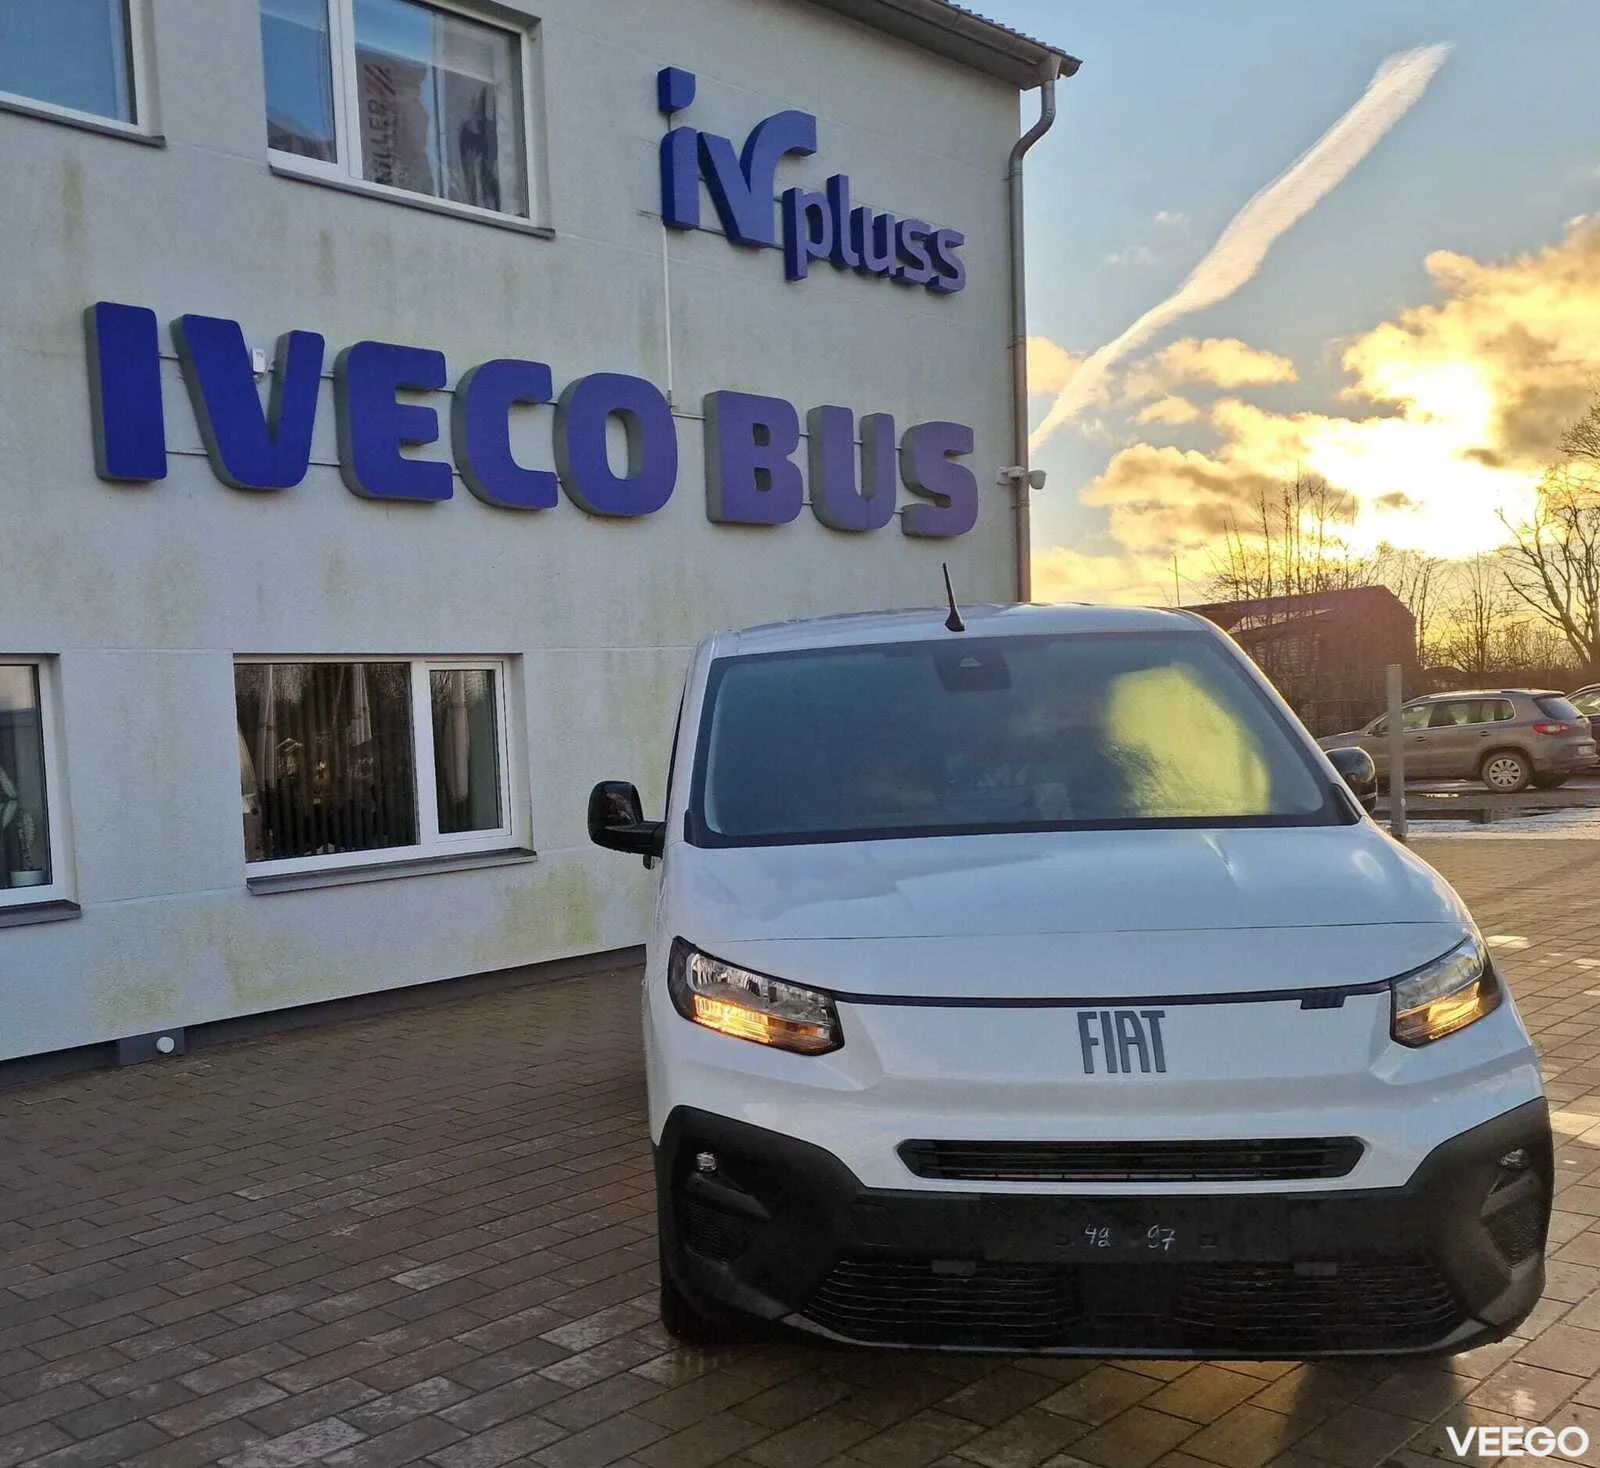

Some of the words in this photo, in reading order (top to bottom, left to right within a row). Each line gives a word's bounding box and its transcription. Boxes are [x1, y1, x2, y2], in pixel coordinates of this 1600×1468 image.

[782, 174, 966, 294] pluss
[85, 301, 678, 519] IVECO
[704, 390, 979, 538] BUS
[1076, 1010, 1167, 1074] FIAT
